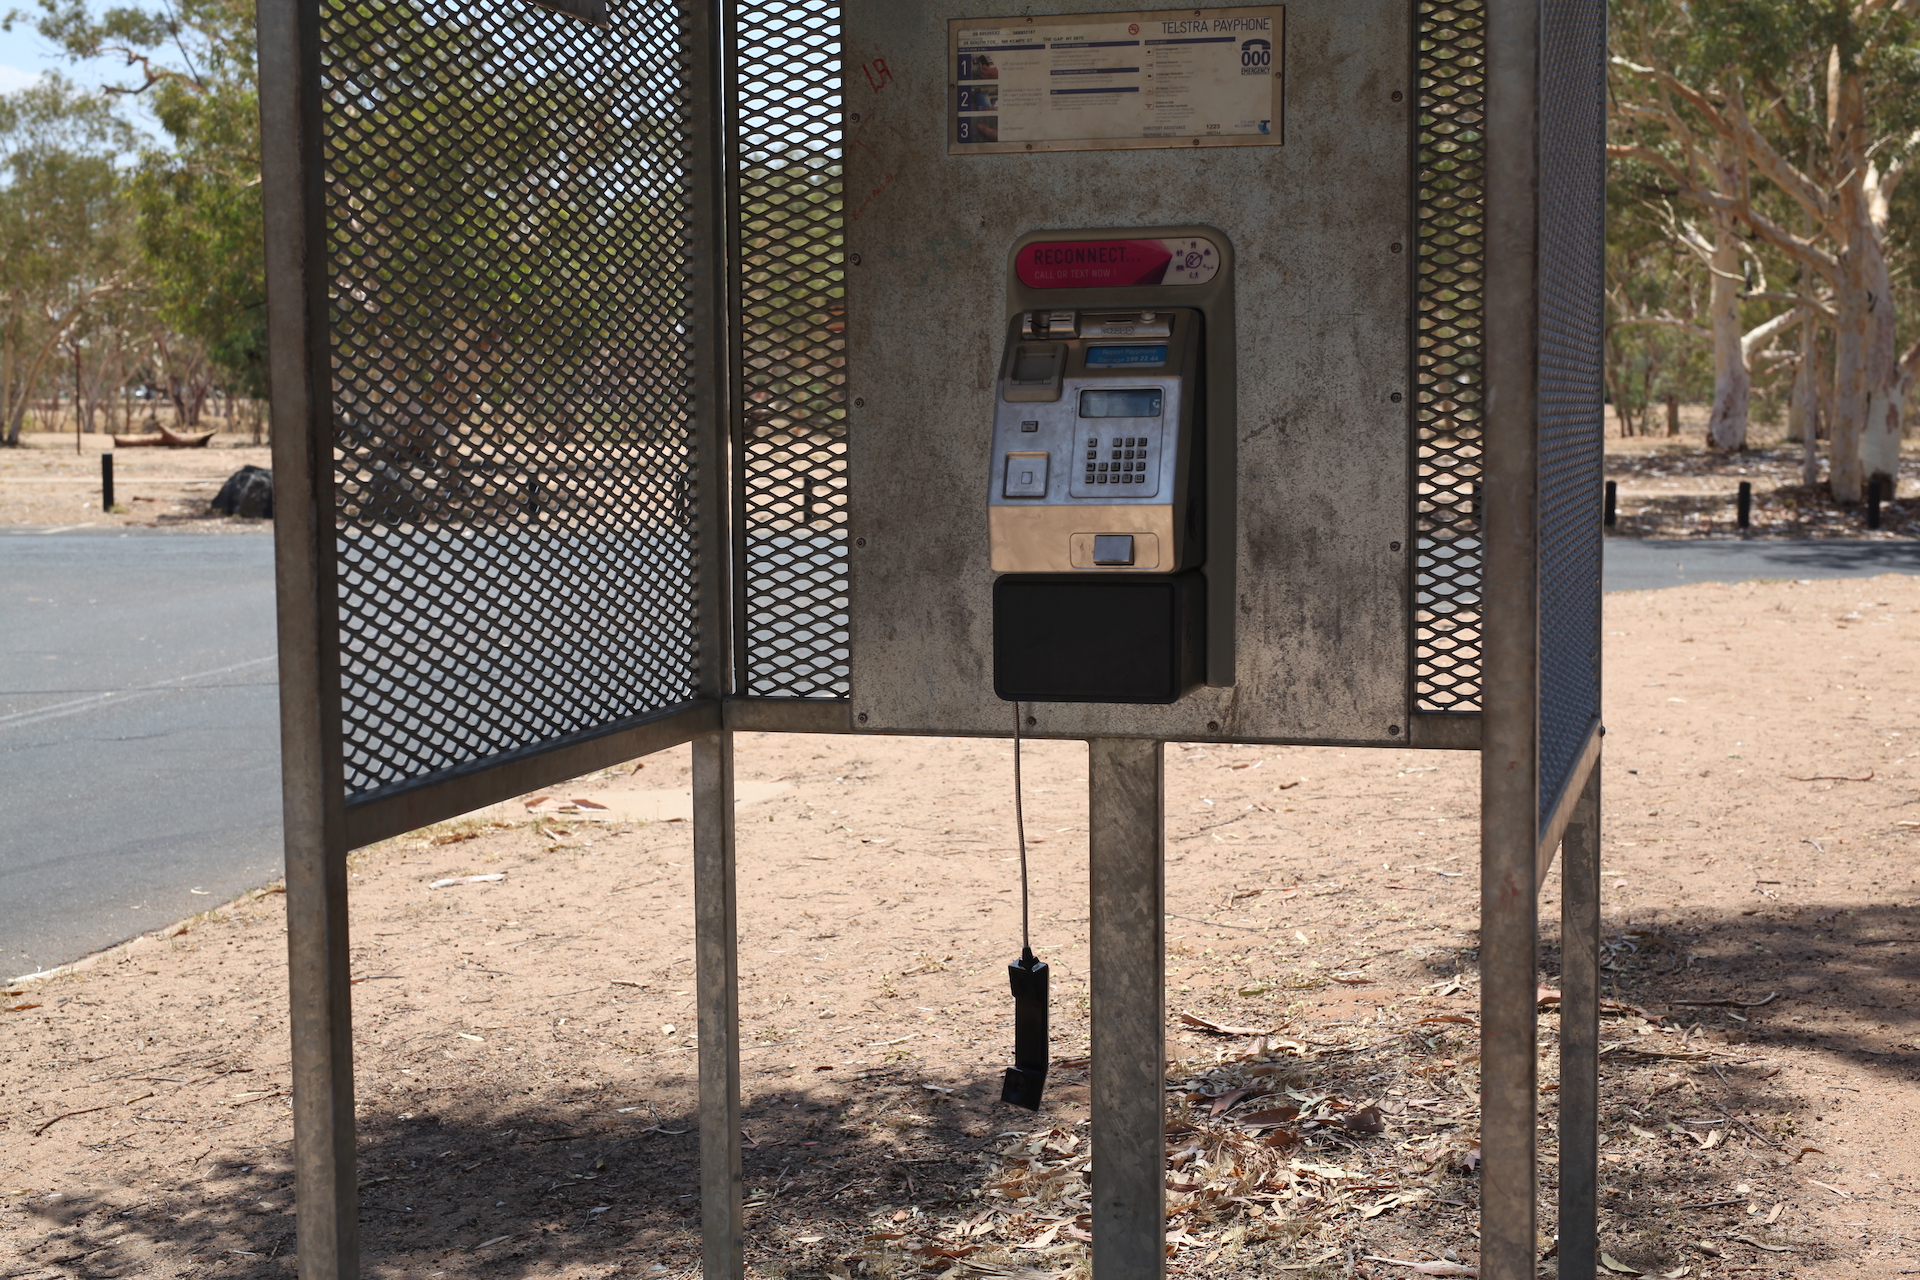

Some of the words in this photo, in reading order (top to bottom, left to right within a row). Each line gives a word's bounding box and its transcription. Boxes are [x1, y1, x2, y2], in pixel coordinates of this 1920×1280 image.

[1162, 21, 1208, 34] TELSTRA
[1214, 18, 1270, 32] PAYPHONE
[1242, 51, 1270, 66] 000
[962, 60, 966, 75] 1
[1241, 67, 1270, 75] EMERGENCY
[961, 92, 968, 106] 2
[961, 123, 968, 138] 3
[1034, 270, 1054, 279] CALL
[1057, 270, 1068, 278] OR
[1070, 269, 1089, 278] TEXT
[1092, 269, 1110, 278] NOW
